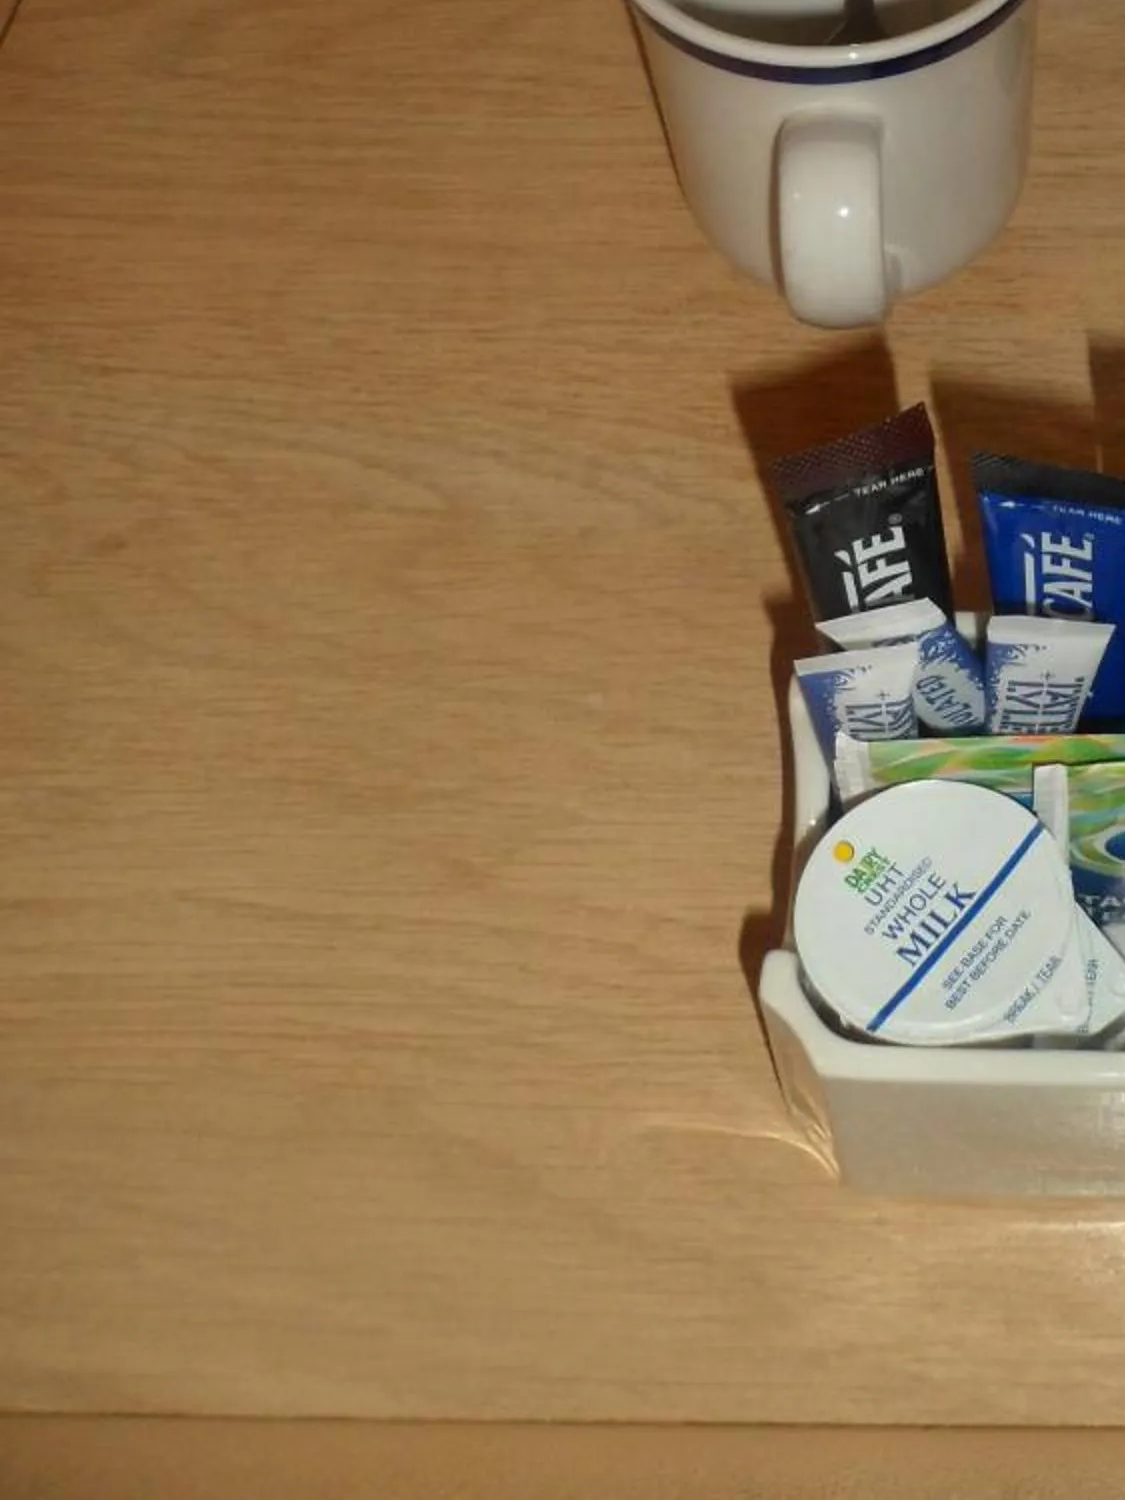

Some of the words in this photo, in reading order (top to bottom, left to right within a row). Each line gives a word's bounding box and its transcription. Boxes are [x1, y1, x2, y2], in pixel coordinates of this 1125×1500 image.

[853, 480, 887, 497] TEAR
[890, 468, 925, 485] HERE
[1087, 511, 1122, 525] HERE
[844, 847, 883, 889] DAIRY
[864, 862, 904, 907] UHT
[882, 872, 947, 940] WHOLE
[896, 880, 977, 968] MILK
[942, 964, 965, 989] SEE
[960, 939, 988, 968] BASE
[985, 915, 1009, 941] FOR
[944, 977, 971, 1011] BEST
[969, 937, 1008, 981] BEFORE
[1004, 909, 1032, 940] DATE
[1003, 987, 1037, 1023] BREAK
[1036, 955, 1063, 982] TEAR
